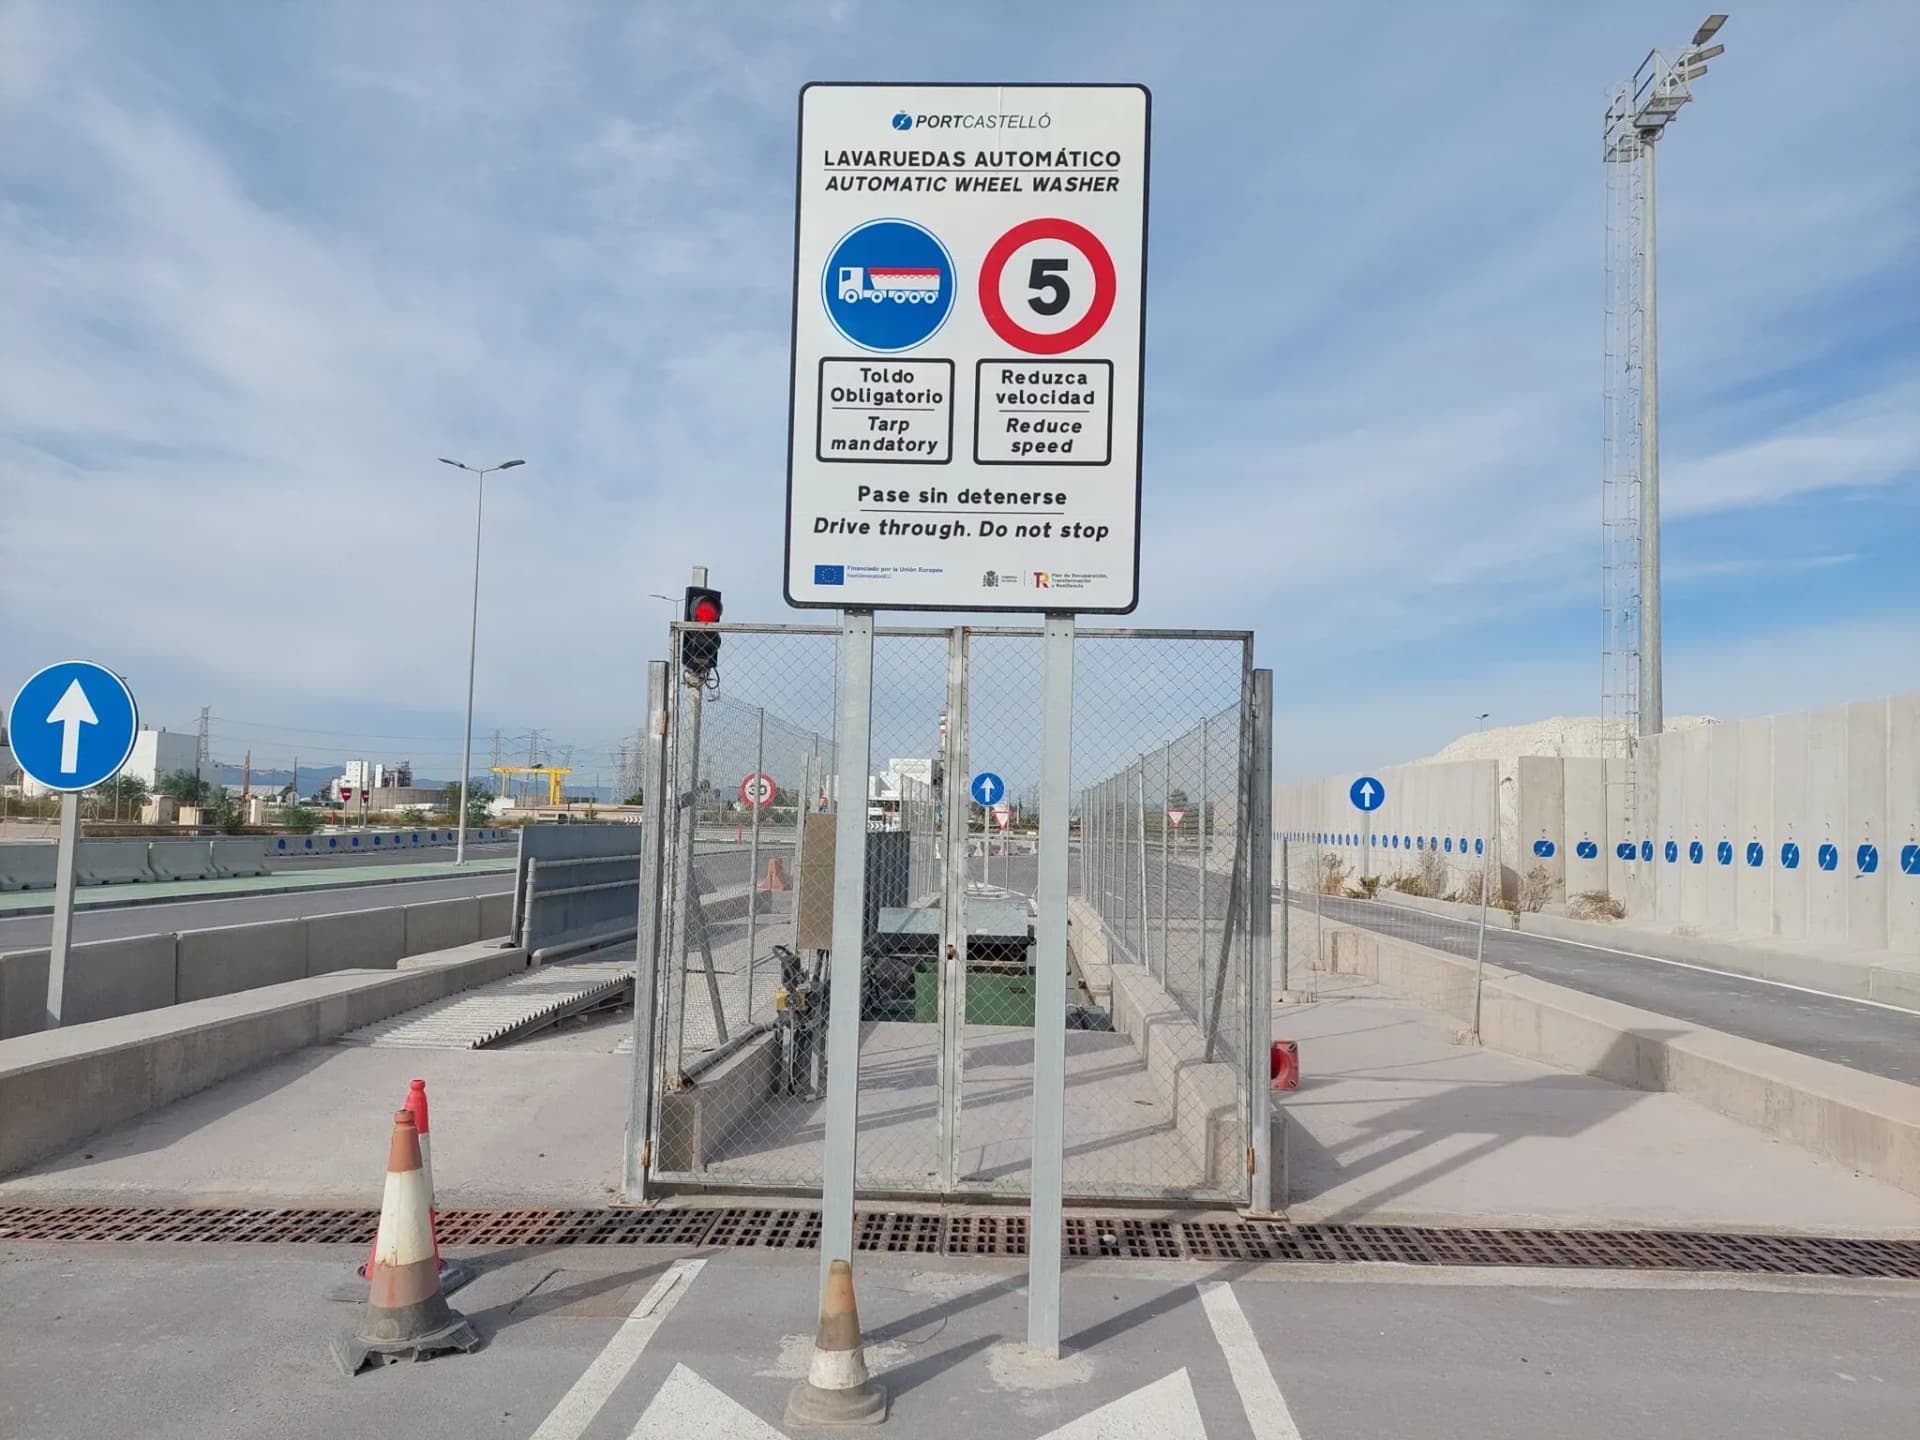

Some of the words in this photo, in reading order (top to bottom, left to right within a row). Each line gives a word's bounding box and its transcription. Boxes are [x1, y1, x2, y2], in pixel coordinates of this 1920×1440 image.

[915, 112, 1051, 129] PORTCASTELLÓ
[824, 150, 966, 168] LAVARUEDAS
[974, 147, 1121, 168] AUTOMÁTICO
[825, 175, 948, 192] AUTOMATIC
[955, 176, 1023, 193] WHEEL
[1032, 176, 1120, 193] WASHER
[1027, 258, 1071, 317] 5
[859, 367, 915, 384] Toldo
[1001, 369, 1088, 385] Reduzca
[830, 387, 943, 406] Obligatorio
[995, 389, 1095, 405] velocidad
[867, 415, 910, 434] Tarp
[1005, 417, 1083, 434] Reduce
[830, 436, 939, 456] mandatory
[1010, 438, 1074, 457] speed
[857, 485, 910, 503] Pase
[918, 486, 948, 504] sin
[957, 487, 1067, 505] detenerse
[813, 516, 871, 535] Drive
[878, 518, 971, 540] through.
[978, 520, 1008, 538] Do
[1015, 521, 1053, 539] not
[1059, 522, 1109, 543] stop
